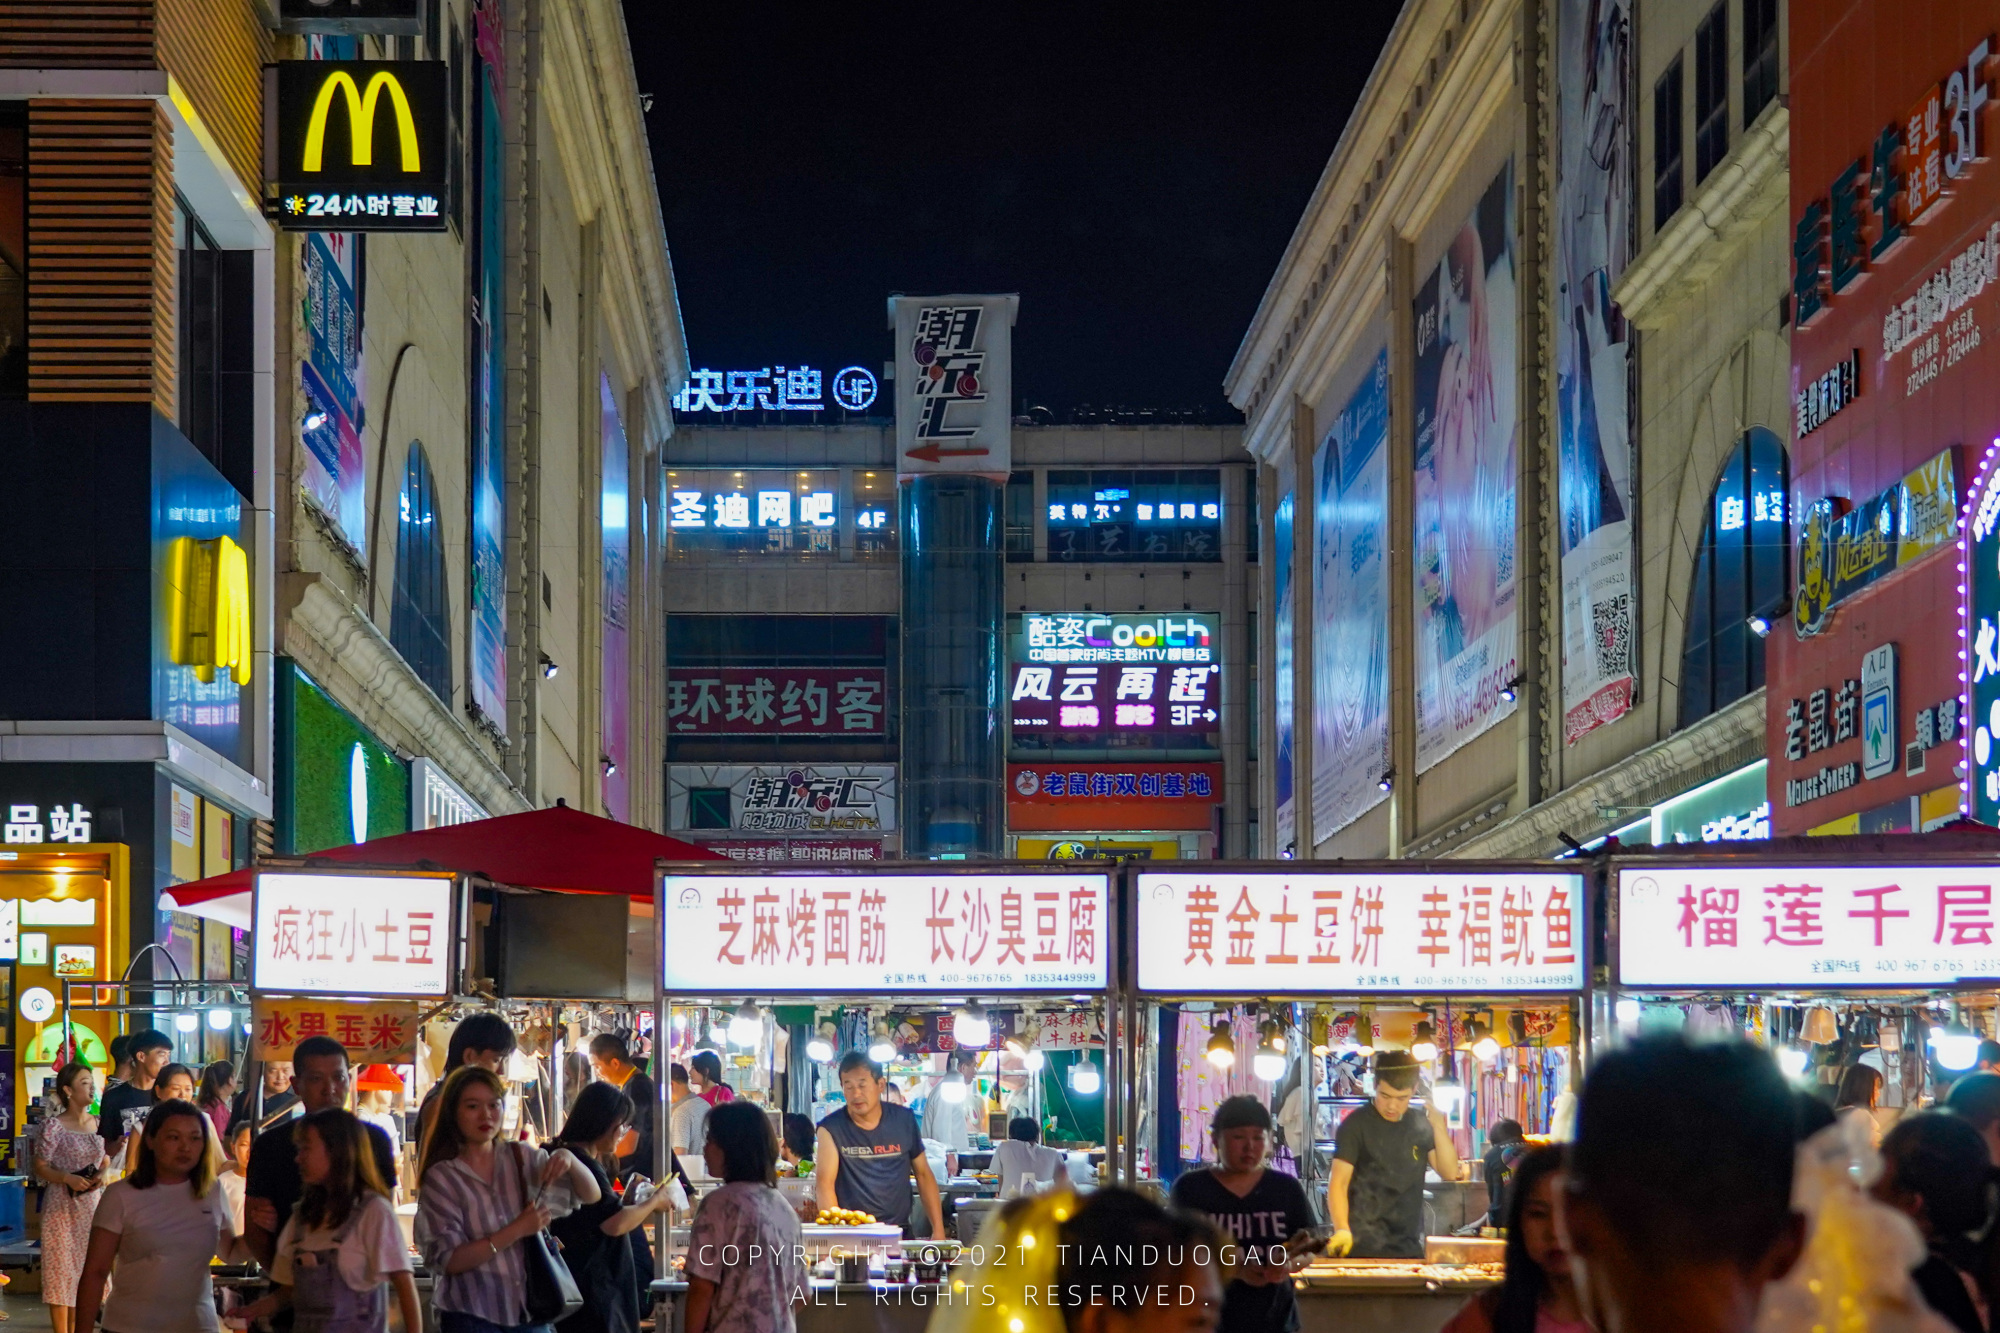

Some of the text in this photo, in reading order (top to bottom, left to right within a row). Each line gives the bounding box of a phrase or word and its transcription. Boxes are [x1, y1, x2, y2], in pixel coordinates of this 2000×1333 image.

[1944, 39, 1988, 178] 3F
[307, 194, 438, 216] 24小时营业
[839, 378, 872, 404] 4F
[670, 491, 836, 528] 圣迪网吧
[857, 511, 886, 528] 4F
[1868, 650, 1888, 674] 入口
[1011, 667, 1211, 702] 风云再起
[668, 677, 882, 729] 环球约客
[1171, 705, 1201, 726] 3F
[1785, 680, 1855, 761] 老鼠街
[1042, 772, 1211, 797] 老鼠街双创基地
[741, 812, 808, 829] 购物城
[717, 886, 1097, 966] 芝麻烤面筋 长沙臭豆腐
[1184, 885, 1575, 968] 黄金土豆饼 幸福鱿鱼
[1676, 883, 1995, 948] 榴莲千层
[273, 905, 434, 964] 疯狂小土豆
[884, 973, 1096, 984] 全国热线 400-9676765 18353449999
[1414, 976, 1488, 985] 400-9676765
[1501, 974, 1574, 985] 18353449999
[260, 1010, 402, 1050] 水果玉米
[1044, 1012, 1087, 1029] 麻辣
